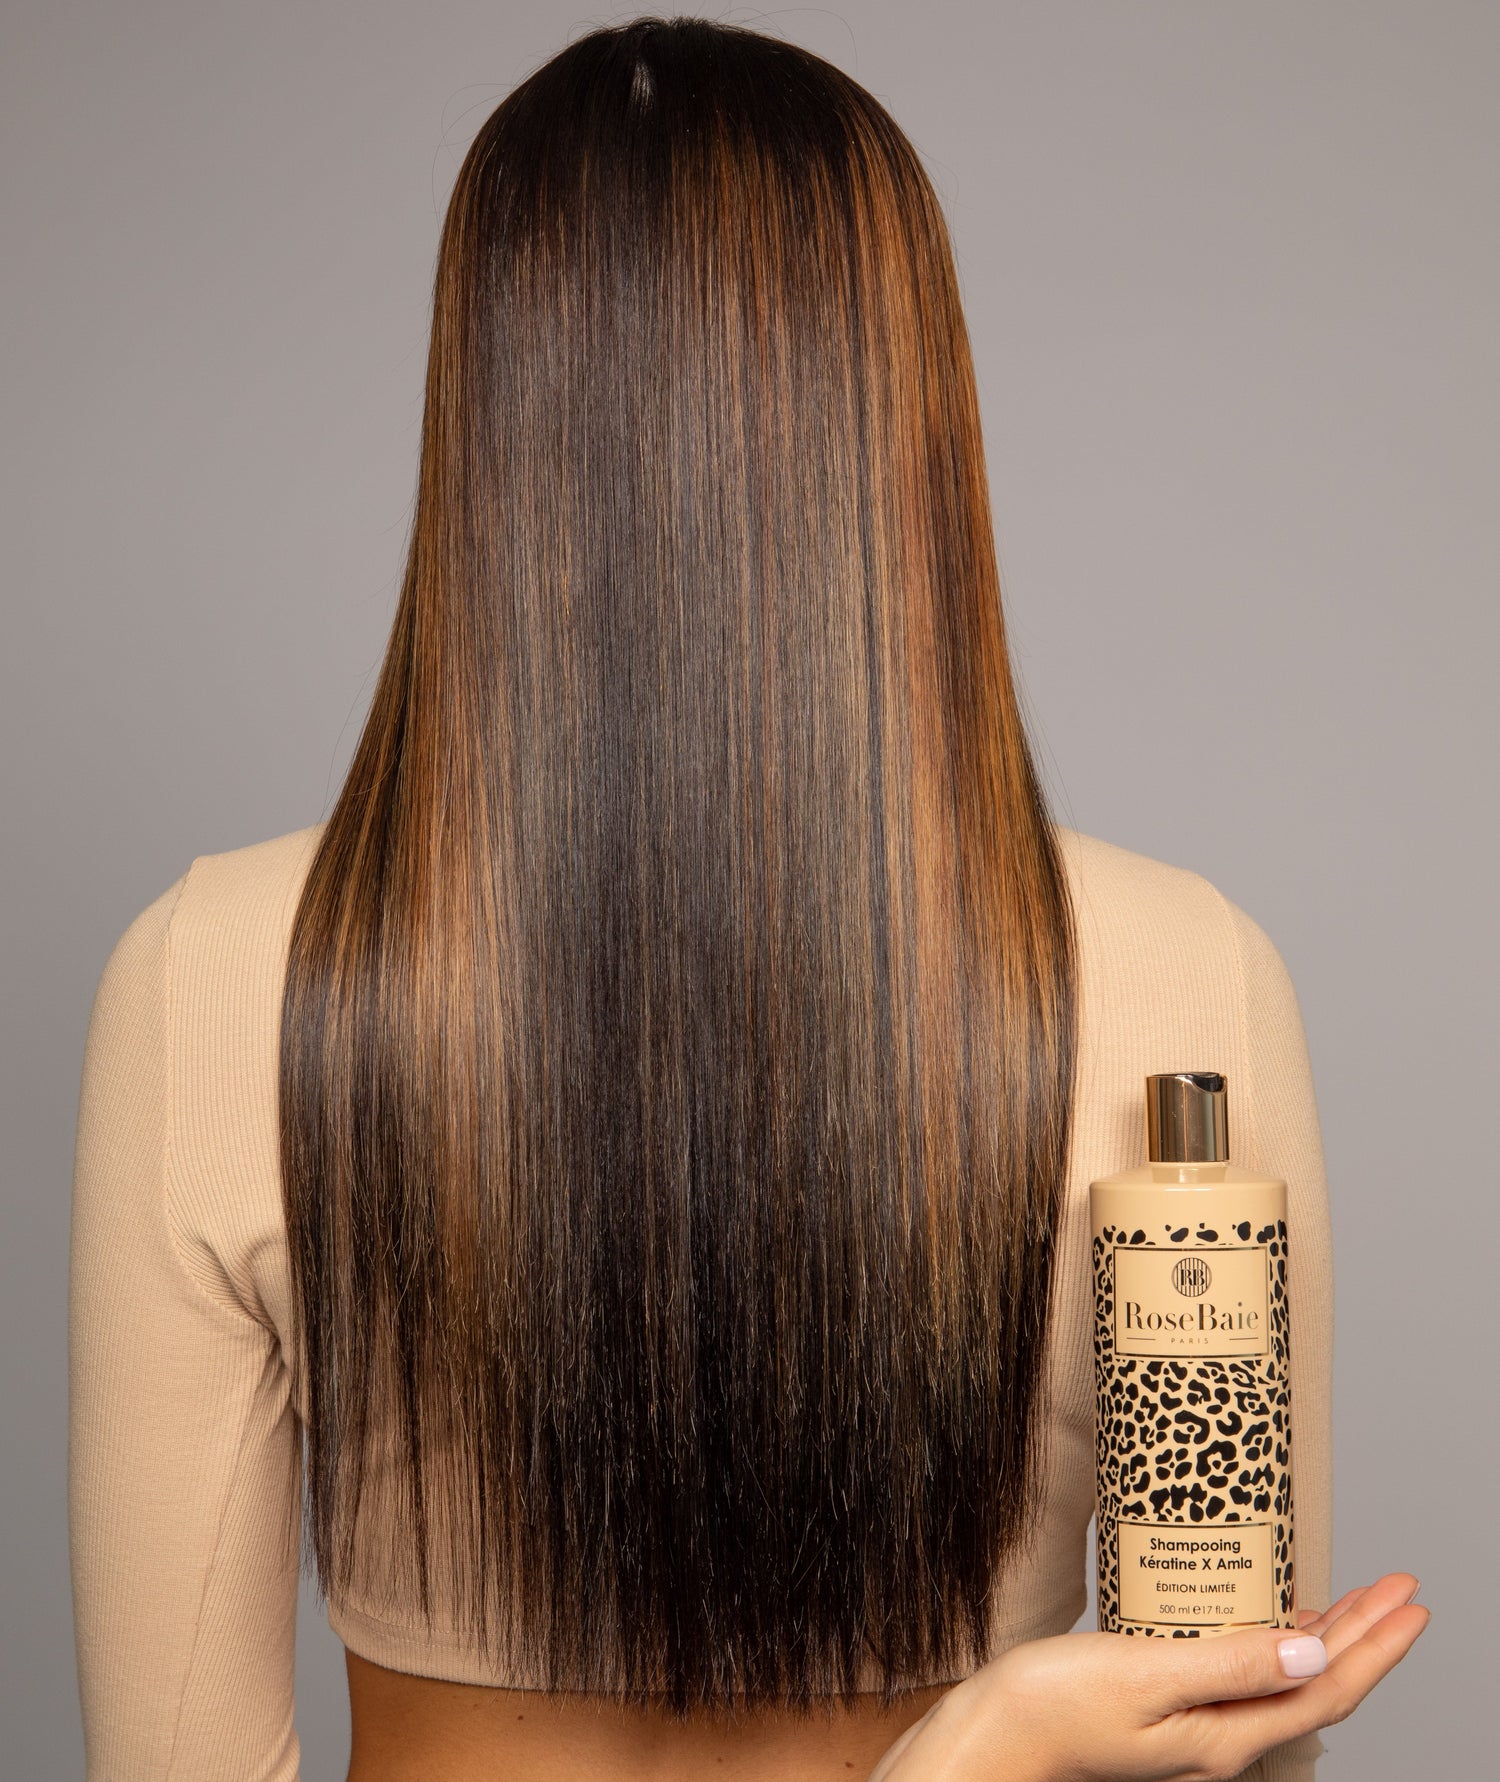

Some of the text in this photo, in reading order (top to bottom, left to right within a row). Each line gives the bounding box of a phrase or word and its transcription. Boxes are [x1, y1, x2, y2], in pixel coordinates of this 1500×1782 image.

[1125, 1301, 1259, 1331] RoseBaie
[1171, 1337, 1209, 1345] PARIS
[1150, 1538, 1241, 1554] Shampooing
[1139, 1555, 1253, 1570] Kératine X Amla
[1156, 1580, 1236, 1593] ÉDITION LIMITÉE
[1159, 1605, 1176, 1614] 500
[1178, 1605, 1190, 1614] ml
